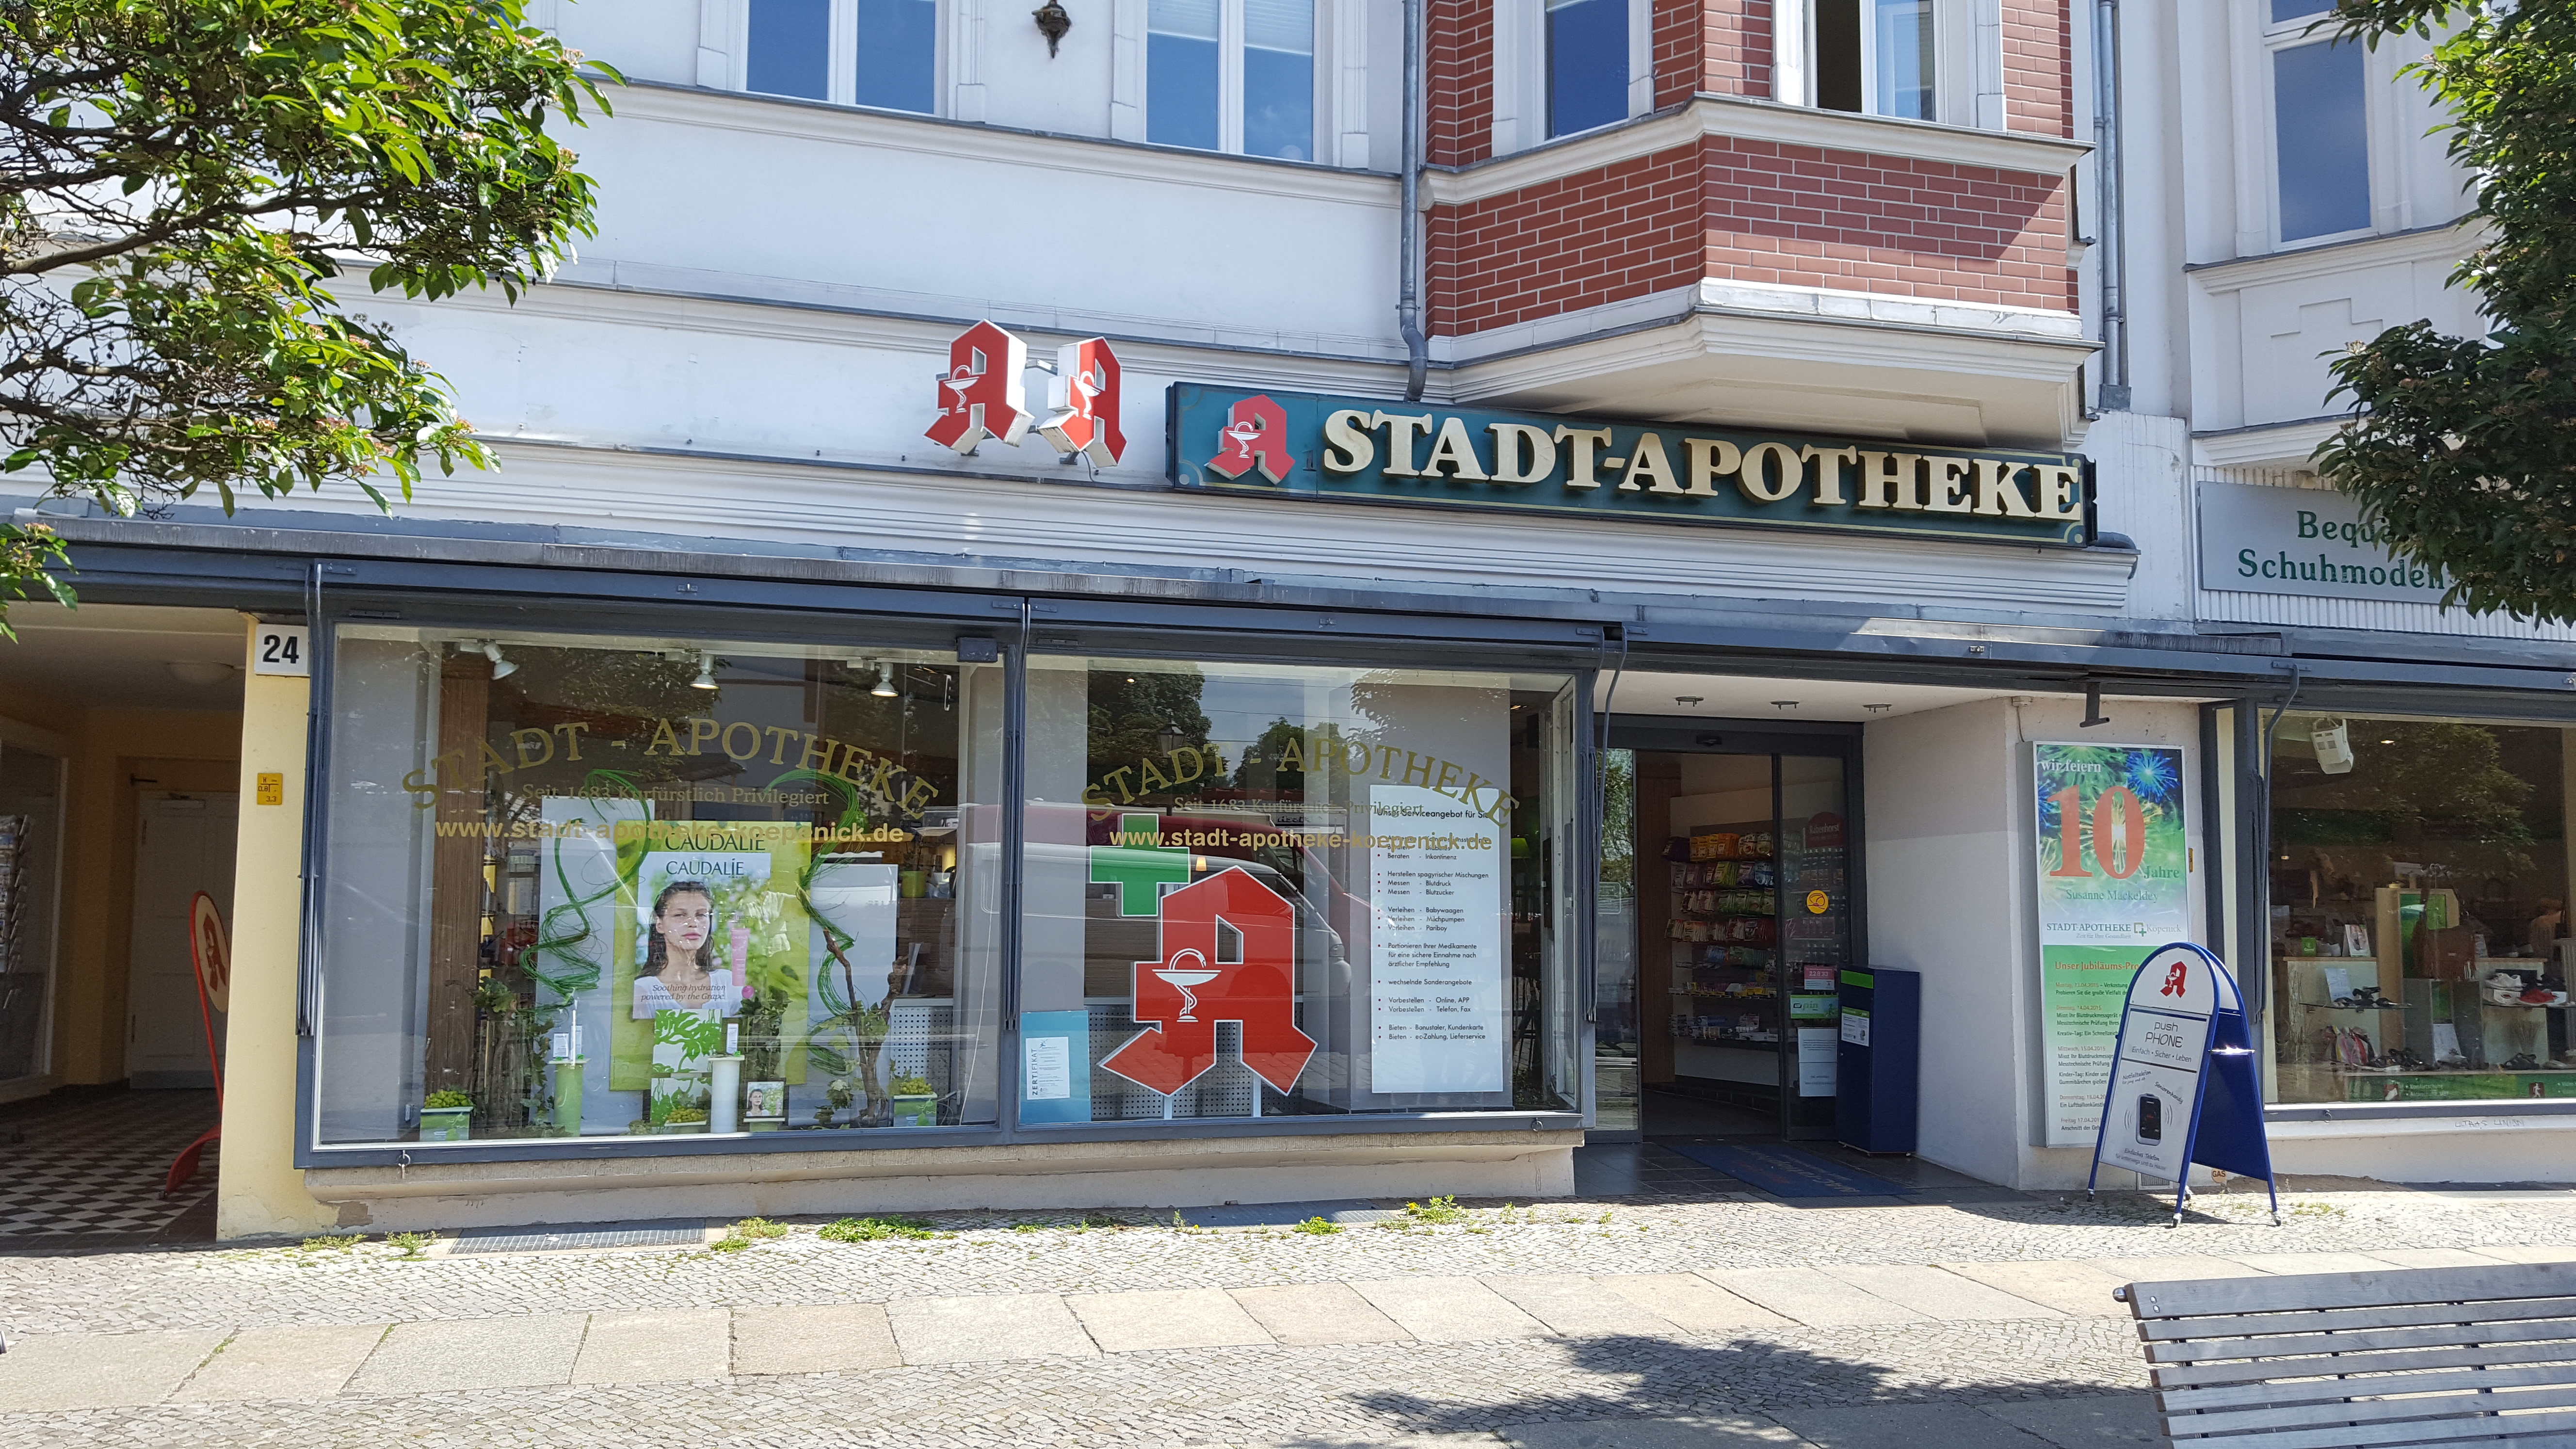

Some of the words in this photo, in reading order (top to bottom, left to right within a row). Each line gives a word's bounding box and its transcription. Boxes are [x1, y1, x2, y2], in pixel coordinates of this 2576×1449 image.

[1323, 409, 2081, 521] STADT-APOTHEKE
[2238, 547, 2445, 590] Schuhmoden
[262, 634, 299, 664] 24
[402, 722, 590, 810] STADT
[644, 718, 939, 820] APOTHEKE
[2041, 758, 2062, 771] wir
[2066, 759, 2101, 773] feiern
[1081, 742, 1232, 821] STADT
[1276, 737, 1520, 829] APOTHEKE
[523, 784, 558, 800] Seit
[568, 785, 612, 800] 1683
[619, 786, 726, 803] Kurfürstlich
[732, 787, 829, 807] Privilegiert
[1174, 797, 1204, 810] Seit
[1345, 801, 1424, 818] Privilegiert
[1402, 809, 1463, 819] Serviceangebot
[436, 819, 903, 846] www.stadt-apotheke-koepenick.de
[1110, 828, 1492, 853] www.stadt-apotheke-koepenick.de
[2046, 784, 2146, 880] 10
[2143, 865, 2180, 879] Jahre
[2066, 889, 2104, 900] Susanne
[2107, 890, 2158, 903] Mackeldey
[2046, 923, 2131, 932] STADT-APOTHEKE
[2055, 961, 2079, 969] Unser
[641, 993, 674, 1002] powered
[676, 993, 685, 1001] by
[652, 984, 687, 993] Soothing
[689, 984, 726, 993] hydration
[2154, 1022, 2178, 1032] push
[2145, 1031, 2183, 1048] PHONE
[2131, 1046, 2150, 1055] Einfach
[2155, 1050, 2171, 1059] Sicher
[2176, 1053, 2192, 1063] Leben
[2155, 1081, 2184, 1104] Seniorenhandy
